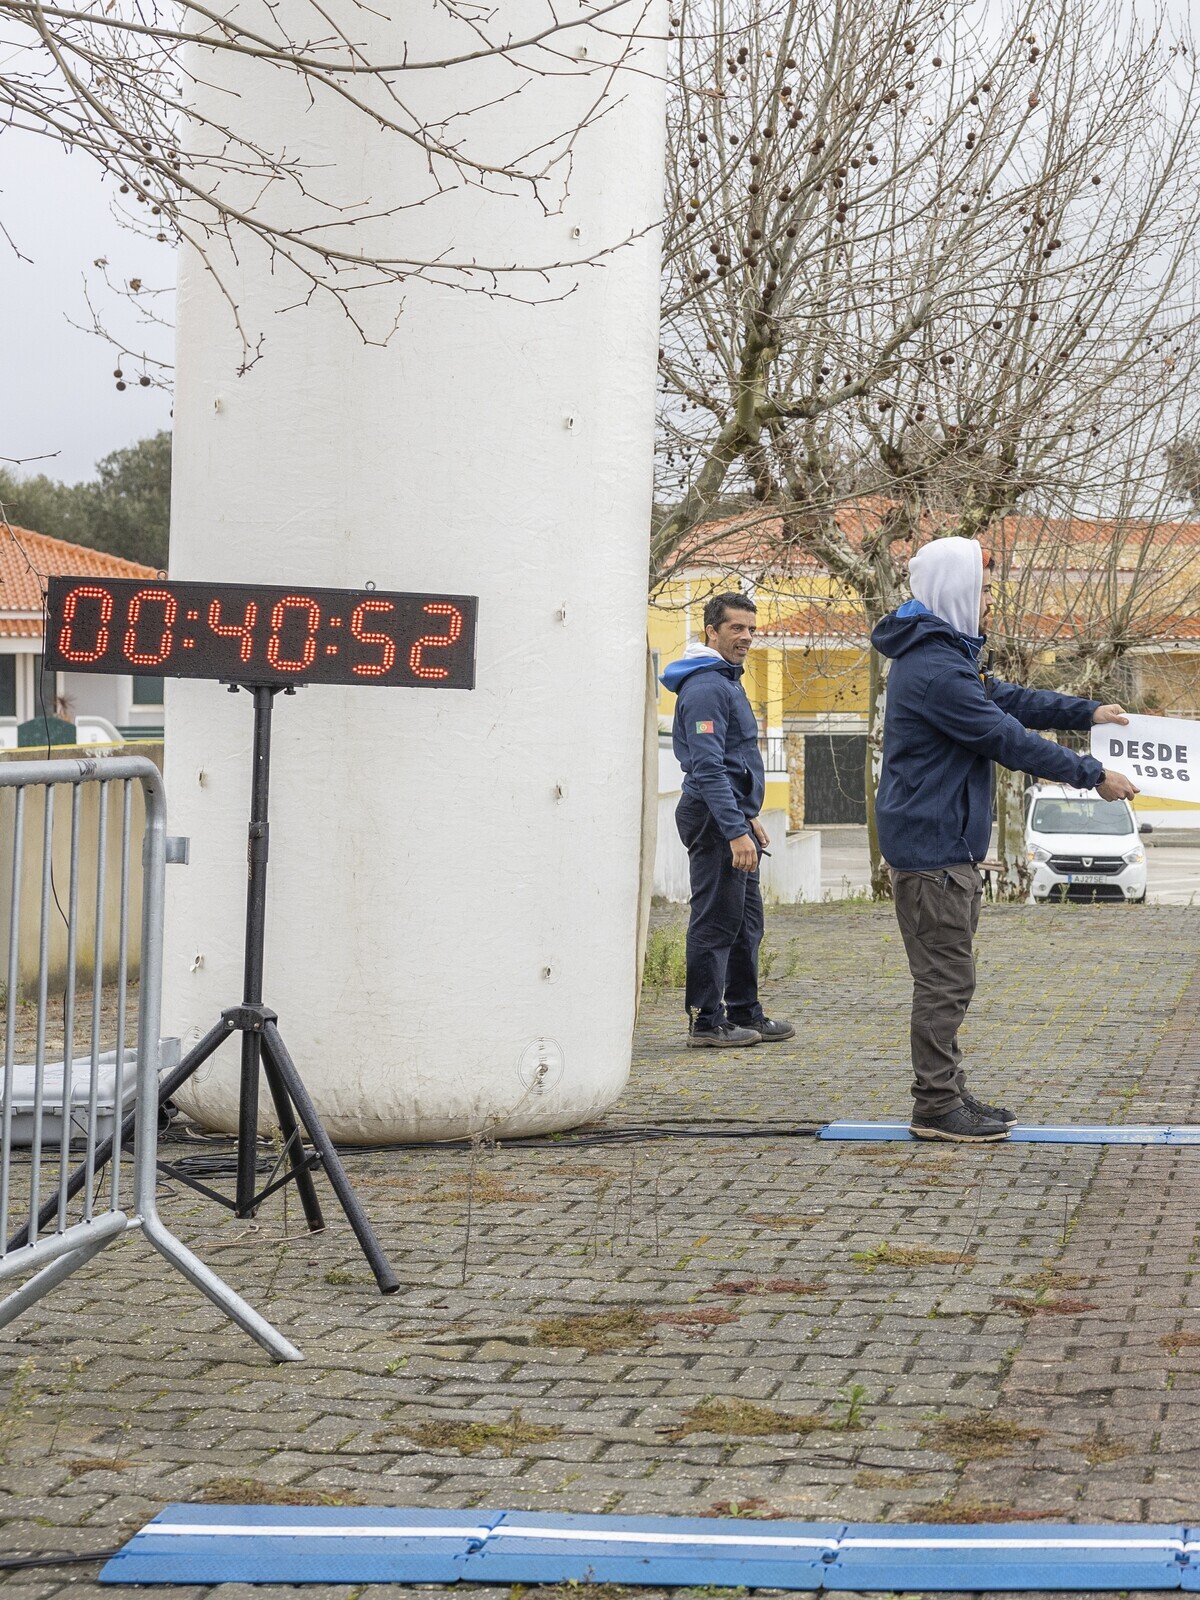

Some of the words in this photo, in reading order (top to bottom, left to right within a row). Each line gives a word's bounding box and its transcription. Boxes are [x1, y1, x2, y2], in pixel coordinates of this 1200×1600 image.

[58, 586, 463, 678] 00:40:52
[1109, 738, 1188, 764] DESDE
[1132, 764, 1190, 782] 1986
